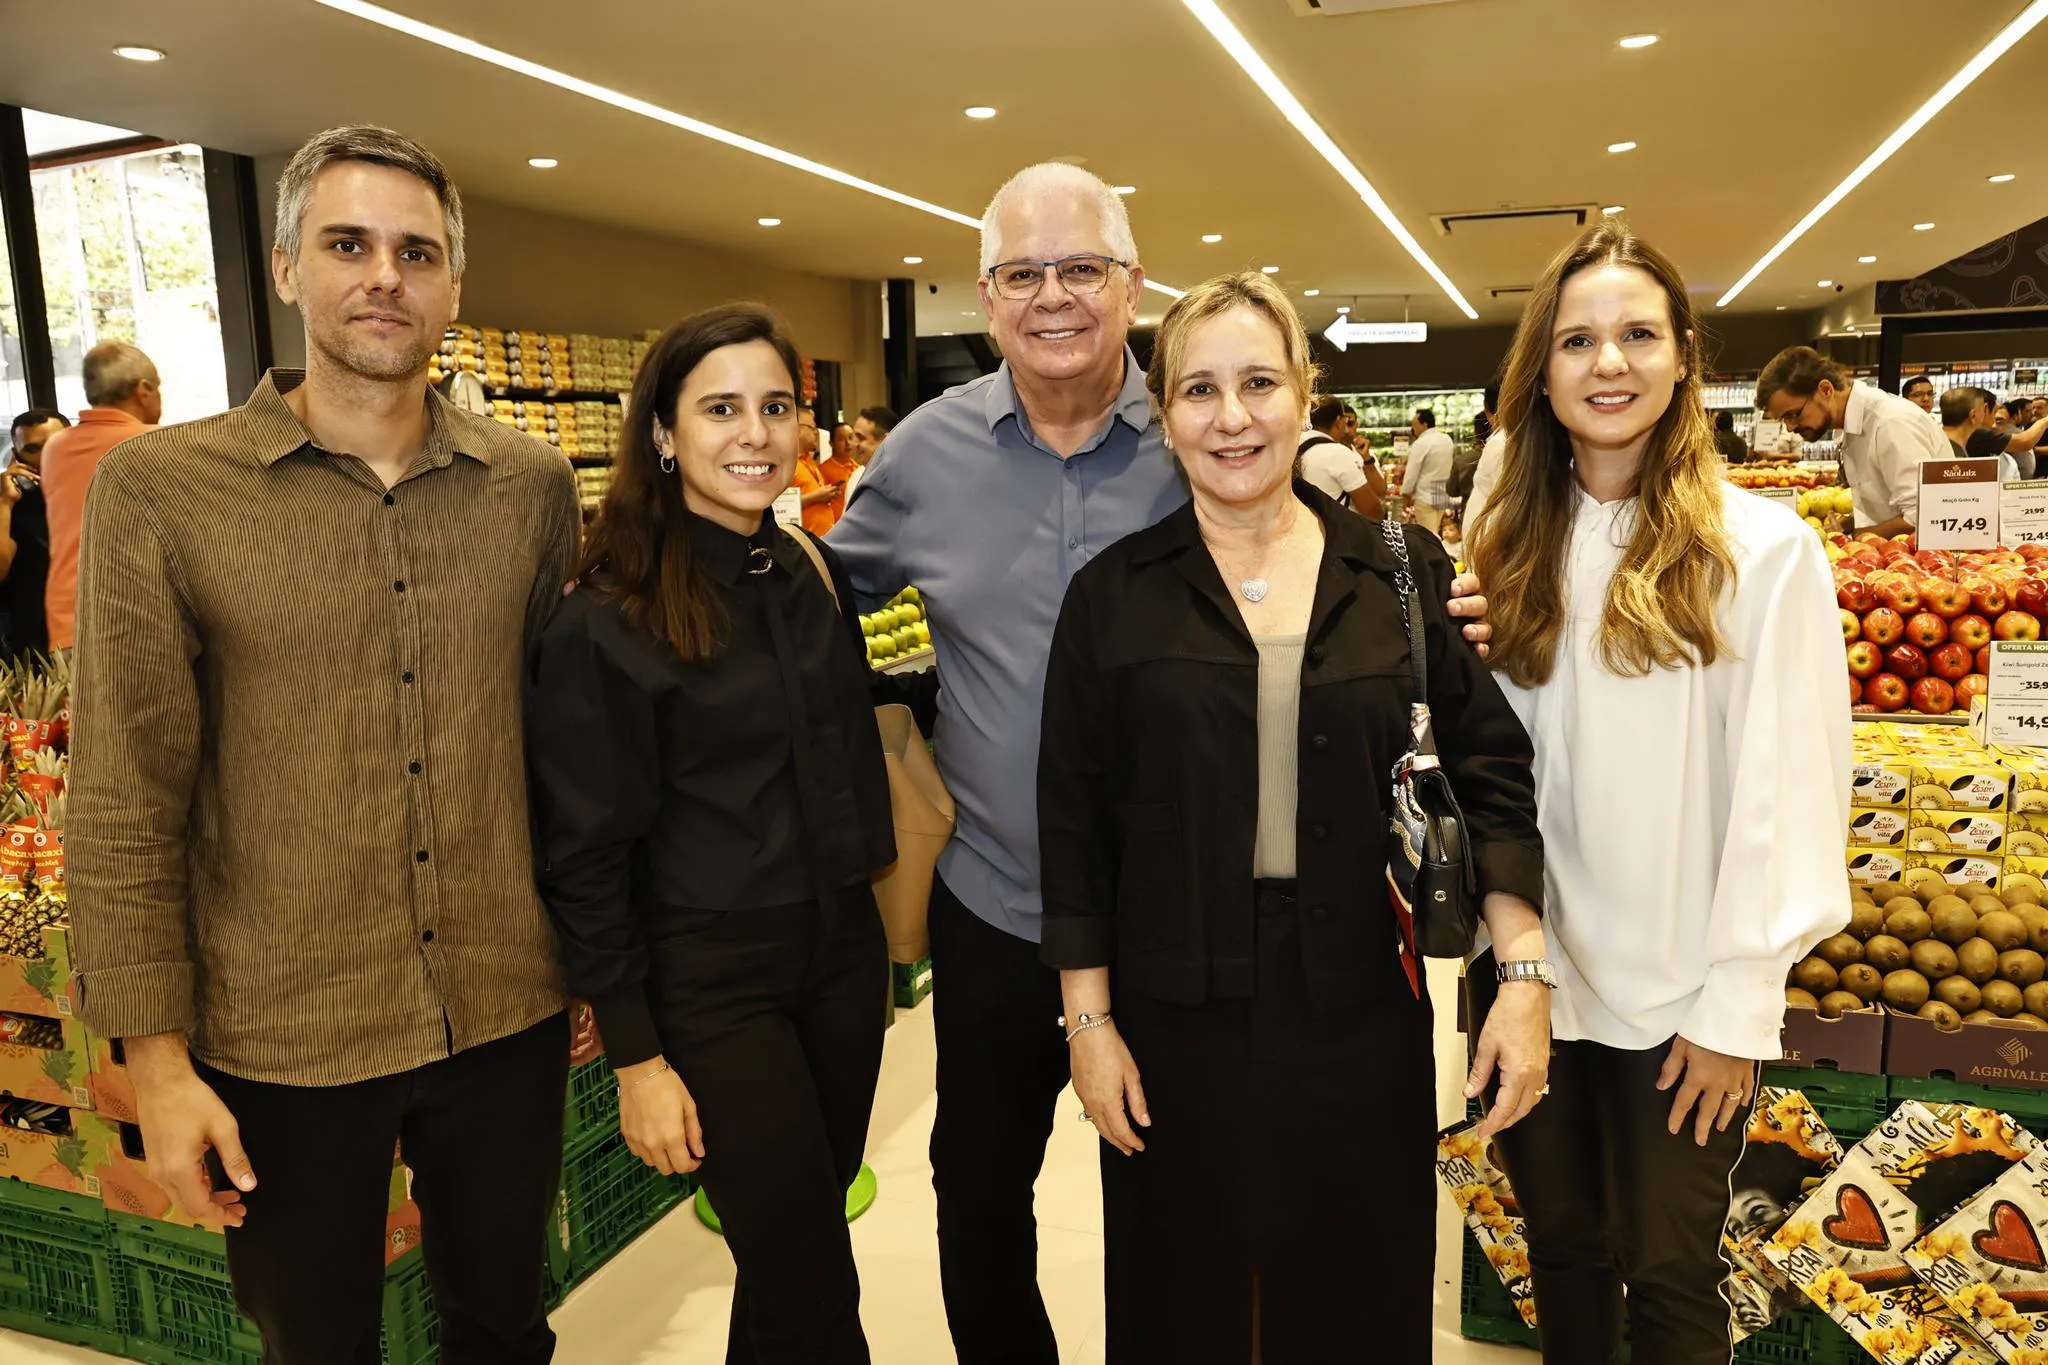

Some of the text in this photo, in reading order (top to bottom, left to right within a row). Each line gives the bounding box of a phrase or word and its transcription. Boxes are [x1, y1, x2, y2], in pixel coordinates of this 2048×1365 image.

[1874, 780, 1897, 789] Zespri
[1971, 784, 1995, 793] Zespri
[1873, 821, 1896, 829] Zespri
[1969, 827, 1993, 836] Zespri
[1869, 863, 1892, 872] Zespri
[1964, 868, 1989, 877] Zespri
[1970, 1065, 2048, 1082] AGRIVALE
